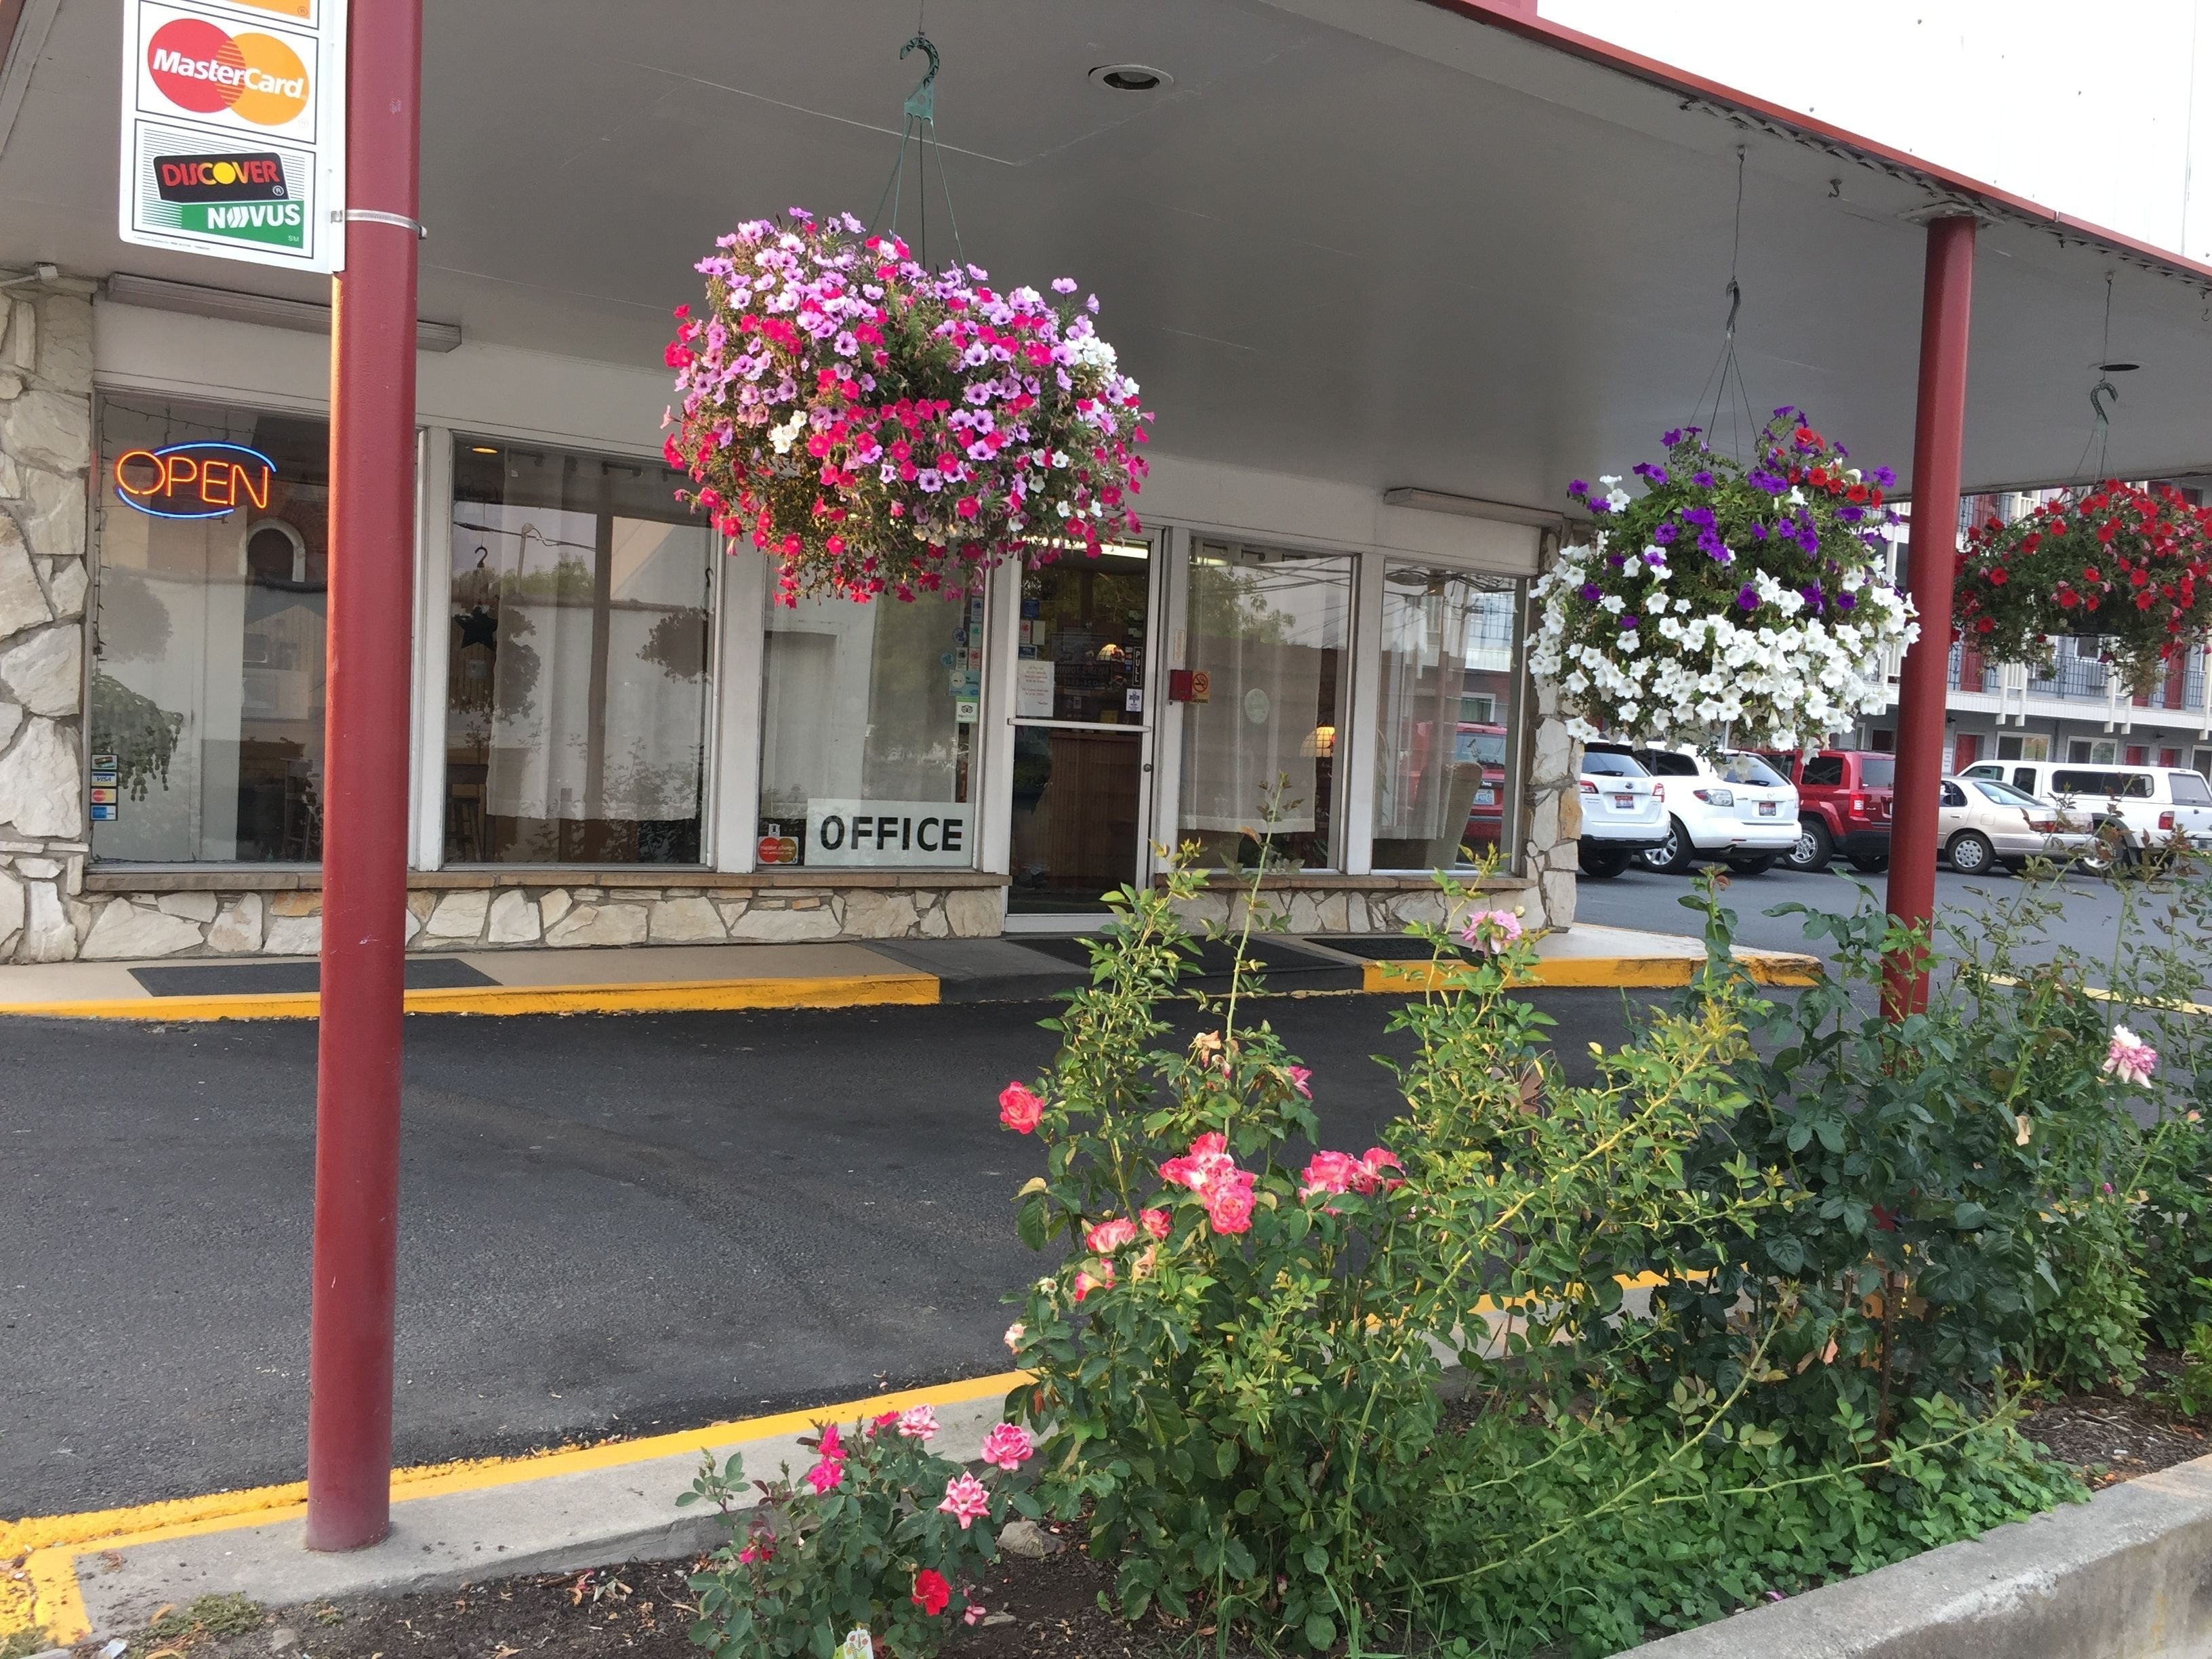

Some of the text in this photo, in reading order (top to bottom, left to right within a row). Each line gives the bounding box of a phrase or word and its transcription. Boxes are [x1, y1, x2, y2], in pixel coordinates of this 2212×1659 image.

[152, 47, 305, 99] MasterCard
[161, 160, 280, 187] DISCOVER
[207, 203, 301, 230] NOVUS
[288, 234, 300, 243] SM
[117, 451, 269, 508] OPEN
[821, 815, 963, 851] OFFICE
